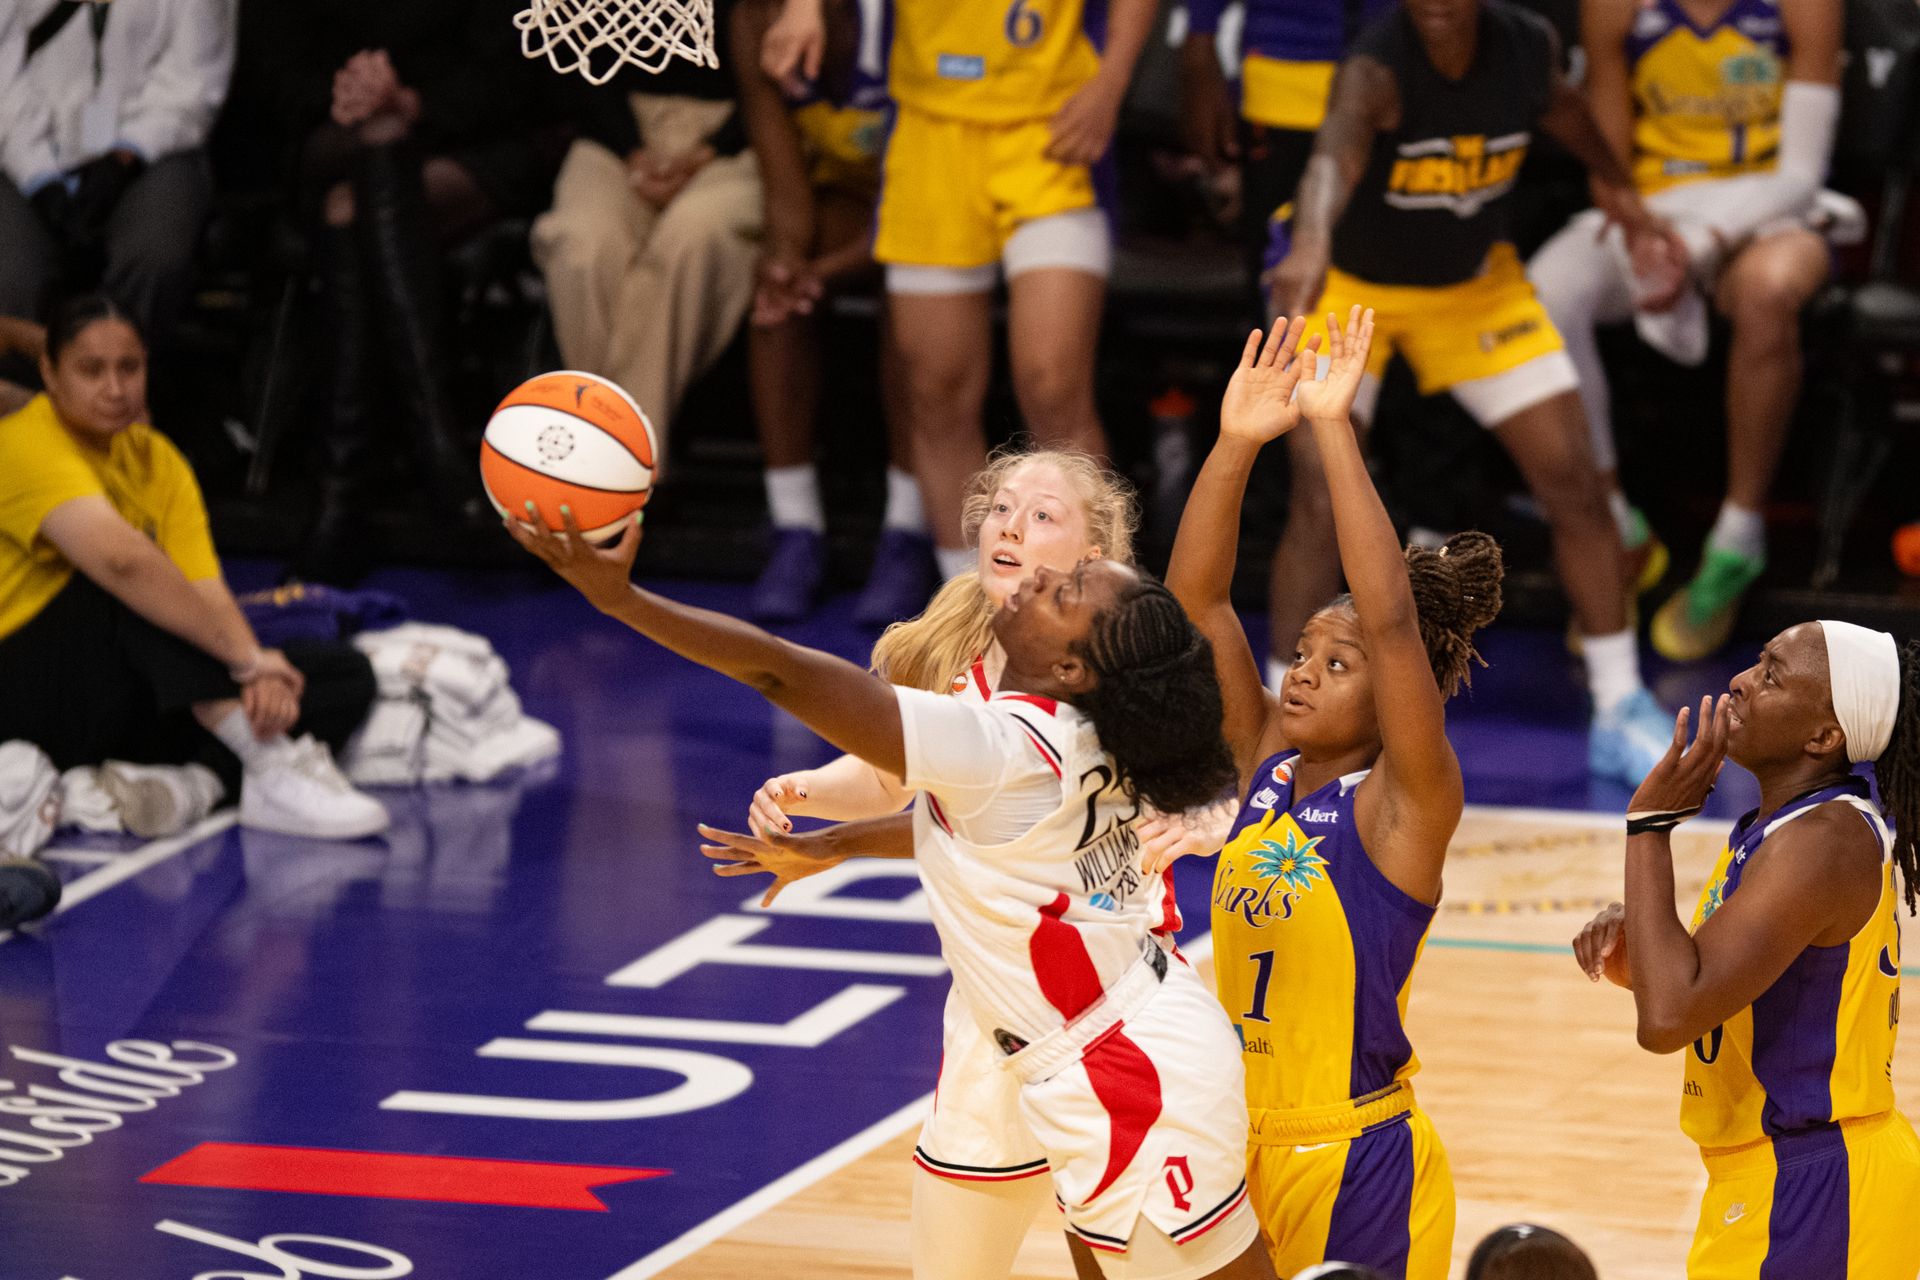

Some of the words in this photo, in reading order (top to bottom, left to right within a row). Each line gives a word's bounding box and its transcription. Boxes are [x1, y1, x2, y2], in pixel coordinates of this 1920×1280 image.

[1004, 0, 1045, 48] 6
[1074, 823, 1140, 893] WILLIAMS
[1241, 949, 1275, 1023] 1
